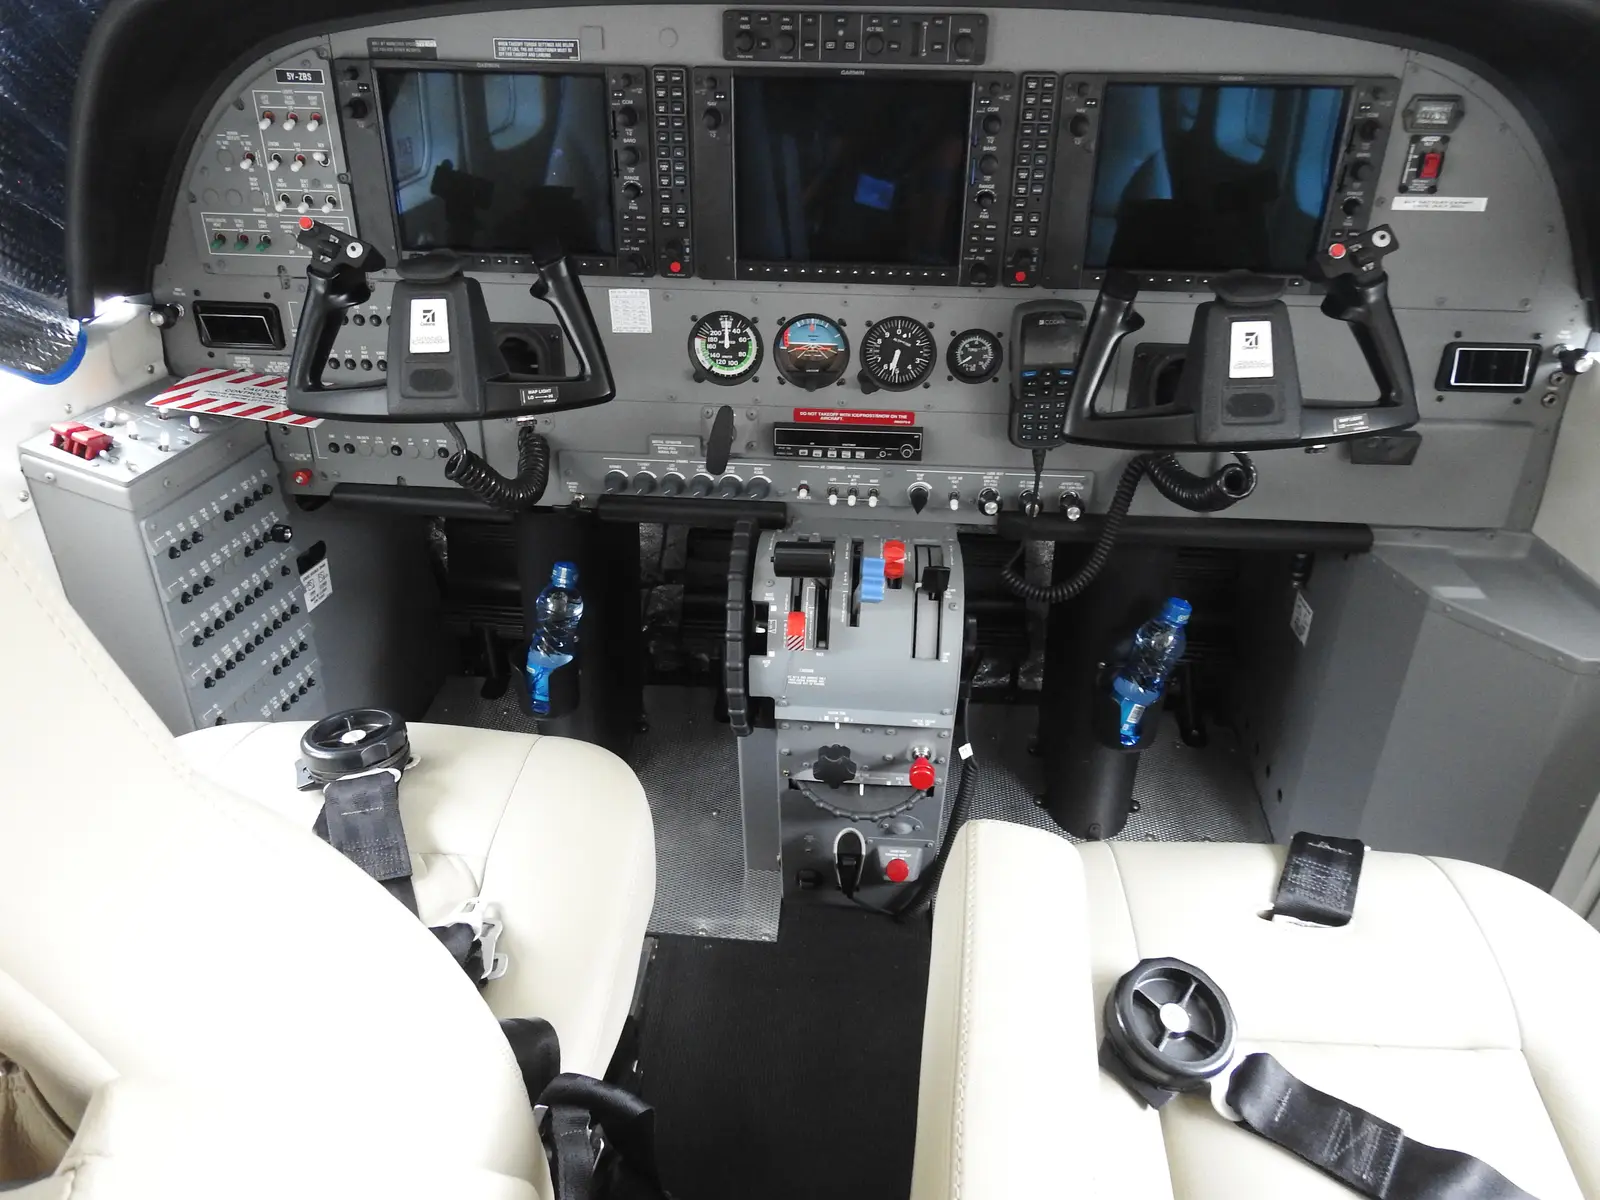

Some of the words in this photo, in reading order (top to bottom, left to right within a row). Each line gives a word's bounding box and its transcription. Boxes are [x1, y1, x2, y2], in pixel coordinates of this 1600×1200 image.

[286, 72, 313, 81] 5Y-ZBS
[224, 388, 263, 396] CONTROL
[243, 387, 280, 395] CAUTION
